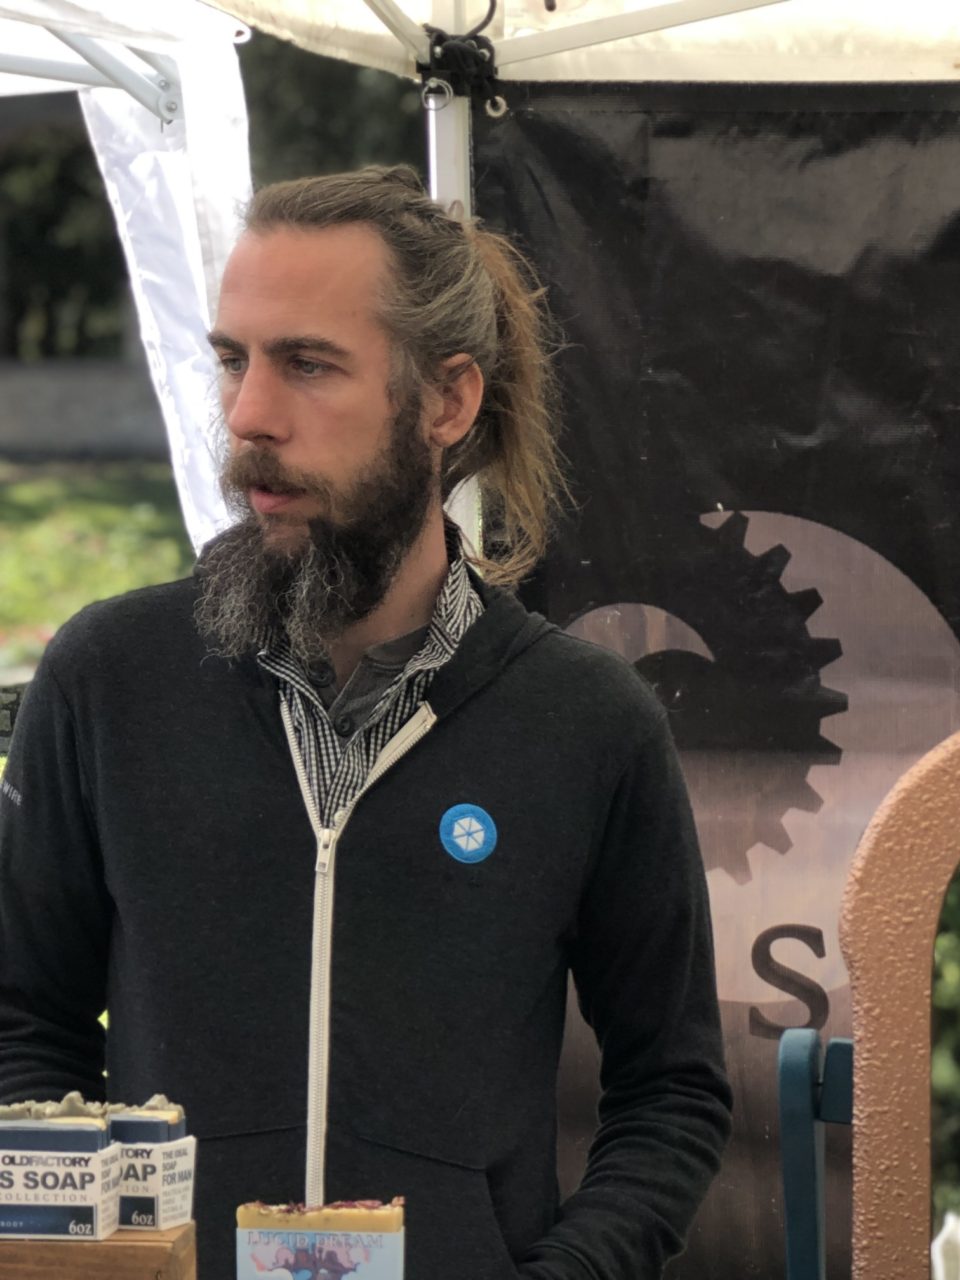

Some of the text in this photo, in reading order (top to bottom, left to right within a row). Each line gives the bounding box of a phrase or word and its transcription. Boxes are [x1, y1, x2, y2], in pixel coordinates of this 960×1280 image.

[1, 1154, 92, 1168] OLDFACTORY
[120, 1163, 157, 1181] AP
[162, 1172, 177, 1187] FOR
[23, 1171, 96, 1191] SOAP
[0, 1192, 88, 1202] OLLECTION
